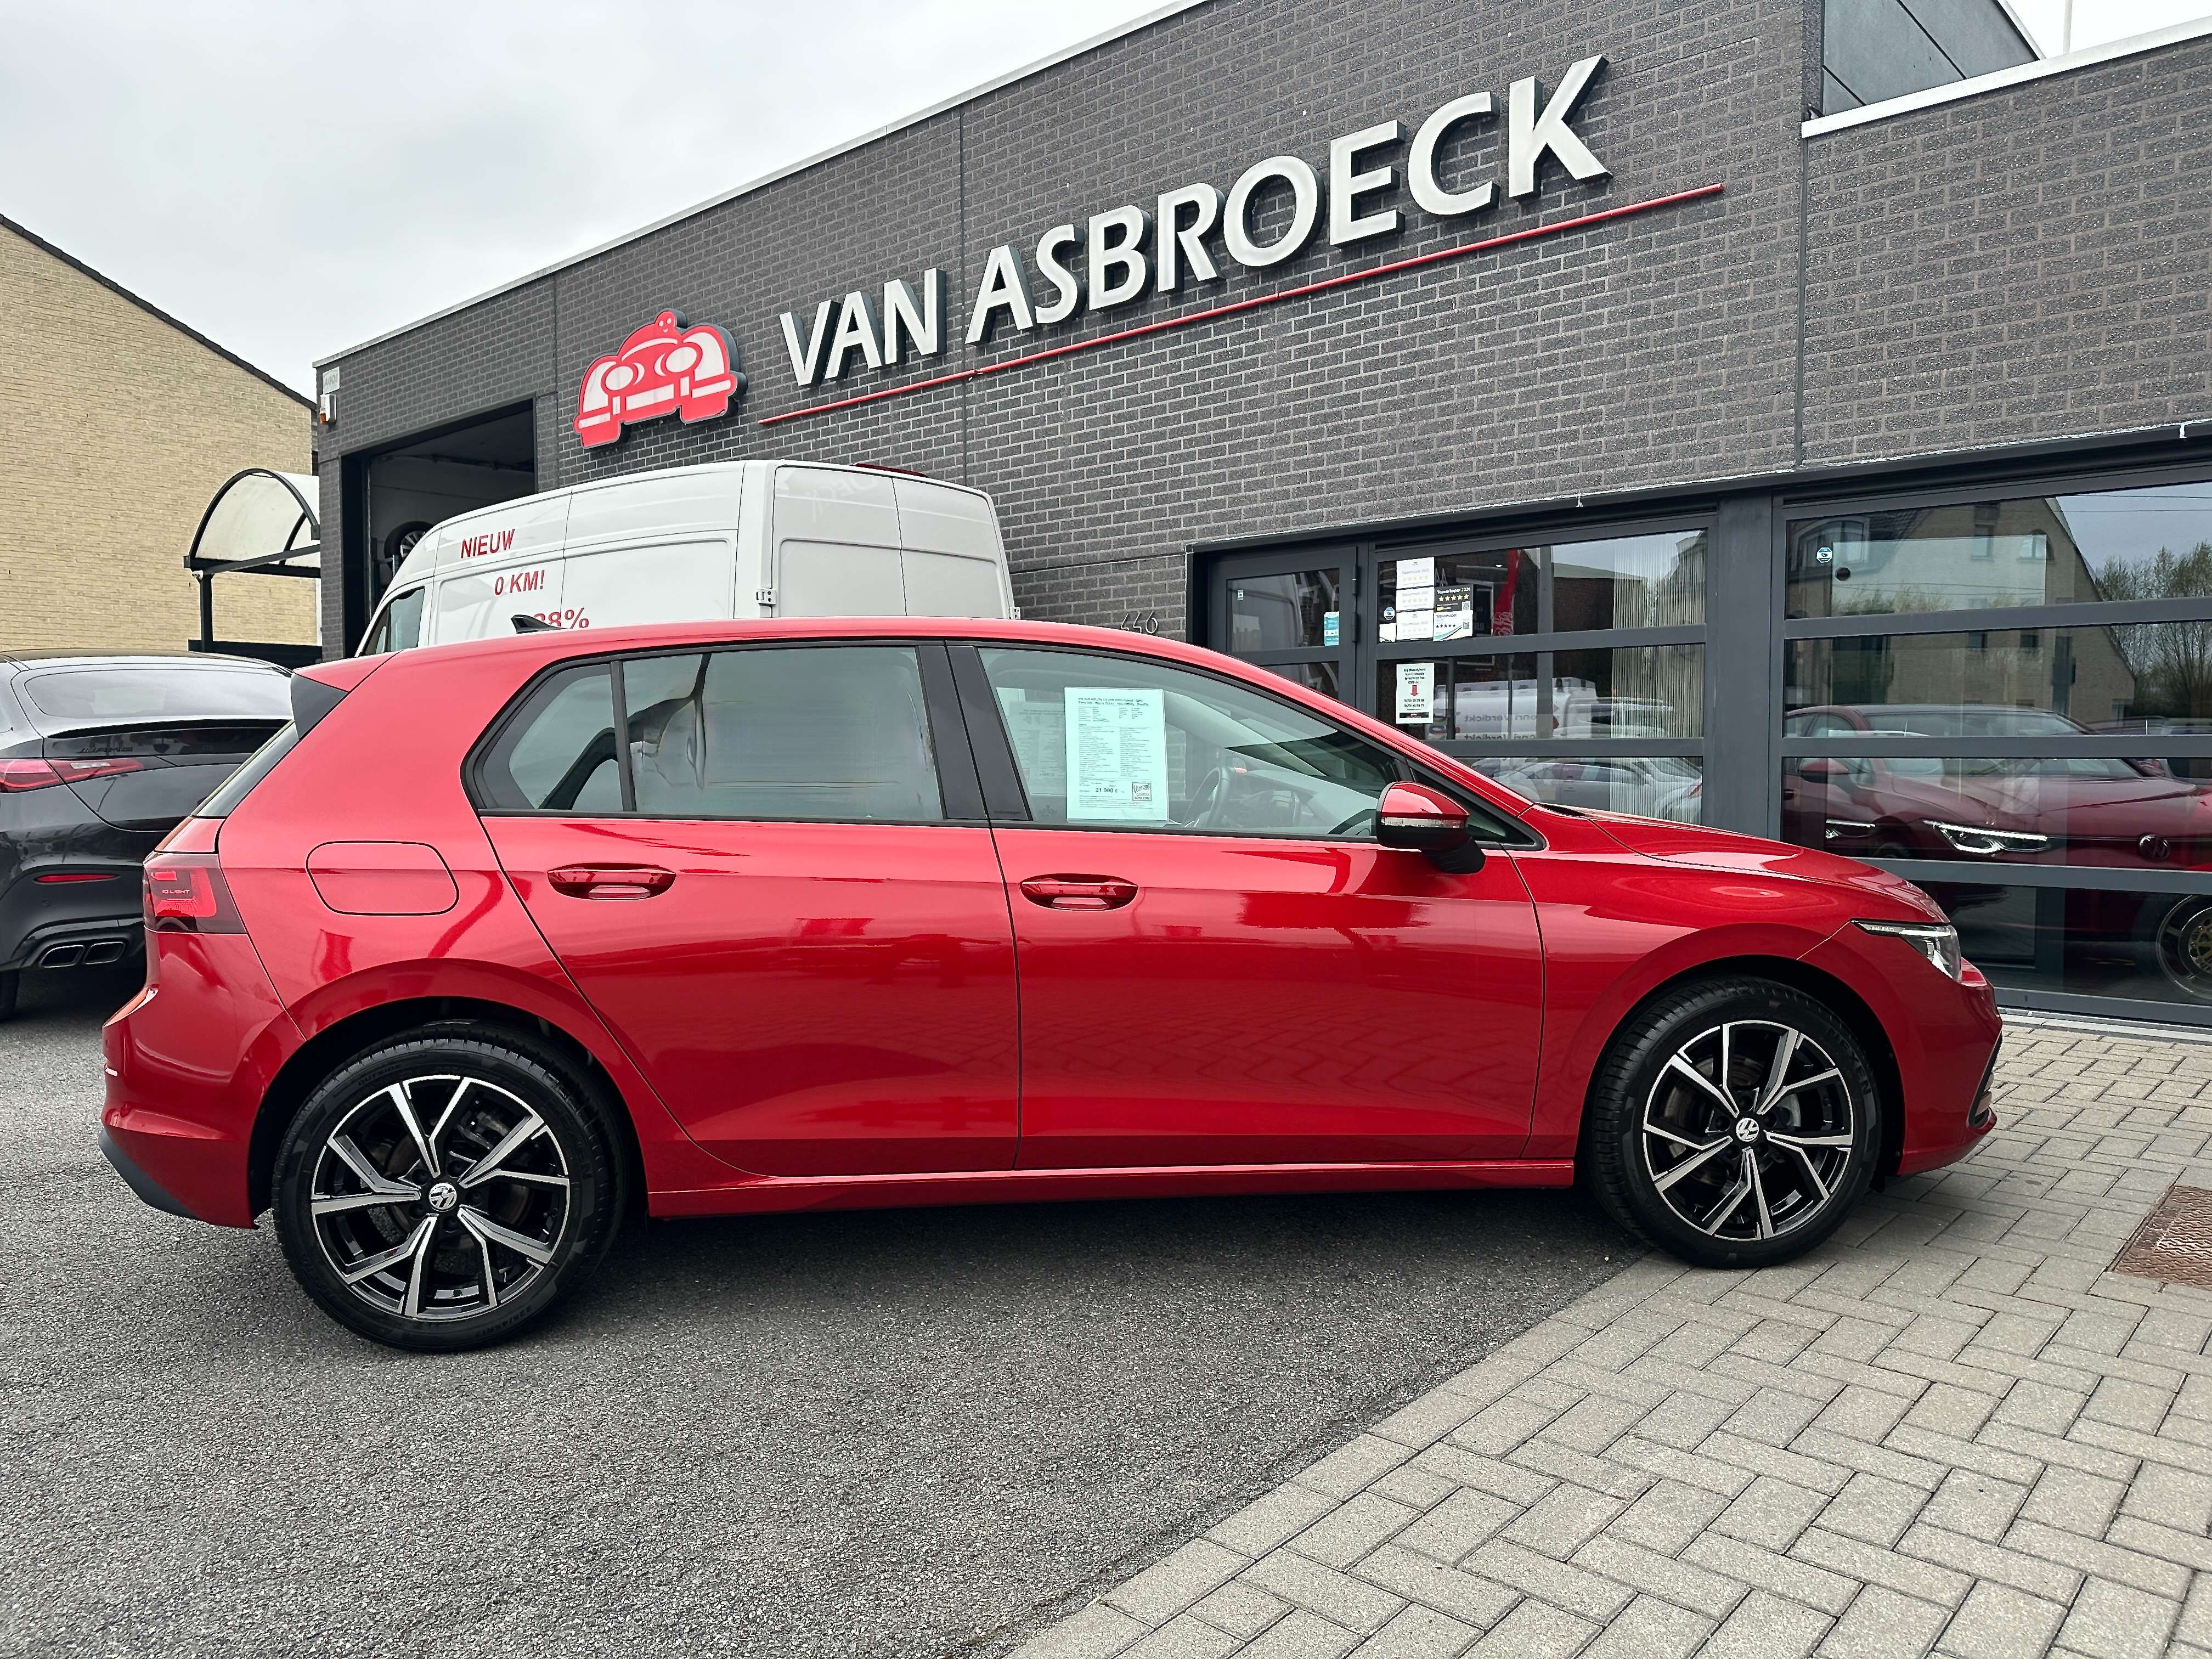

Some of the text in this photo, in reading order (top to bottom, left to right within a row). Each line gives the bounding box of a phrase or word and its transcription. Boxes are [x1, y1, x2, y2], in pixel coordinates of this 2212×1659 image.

[779, 53, 1612, 387] VAN ASBROECK
[461, 528, 515, 559] NIEUW
[494, 569, 545, 596] 0 KM!
